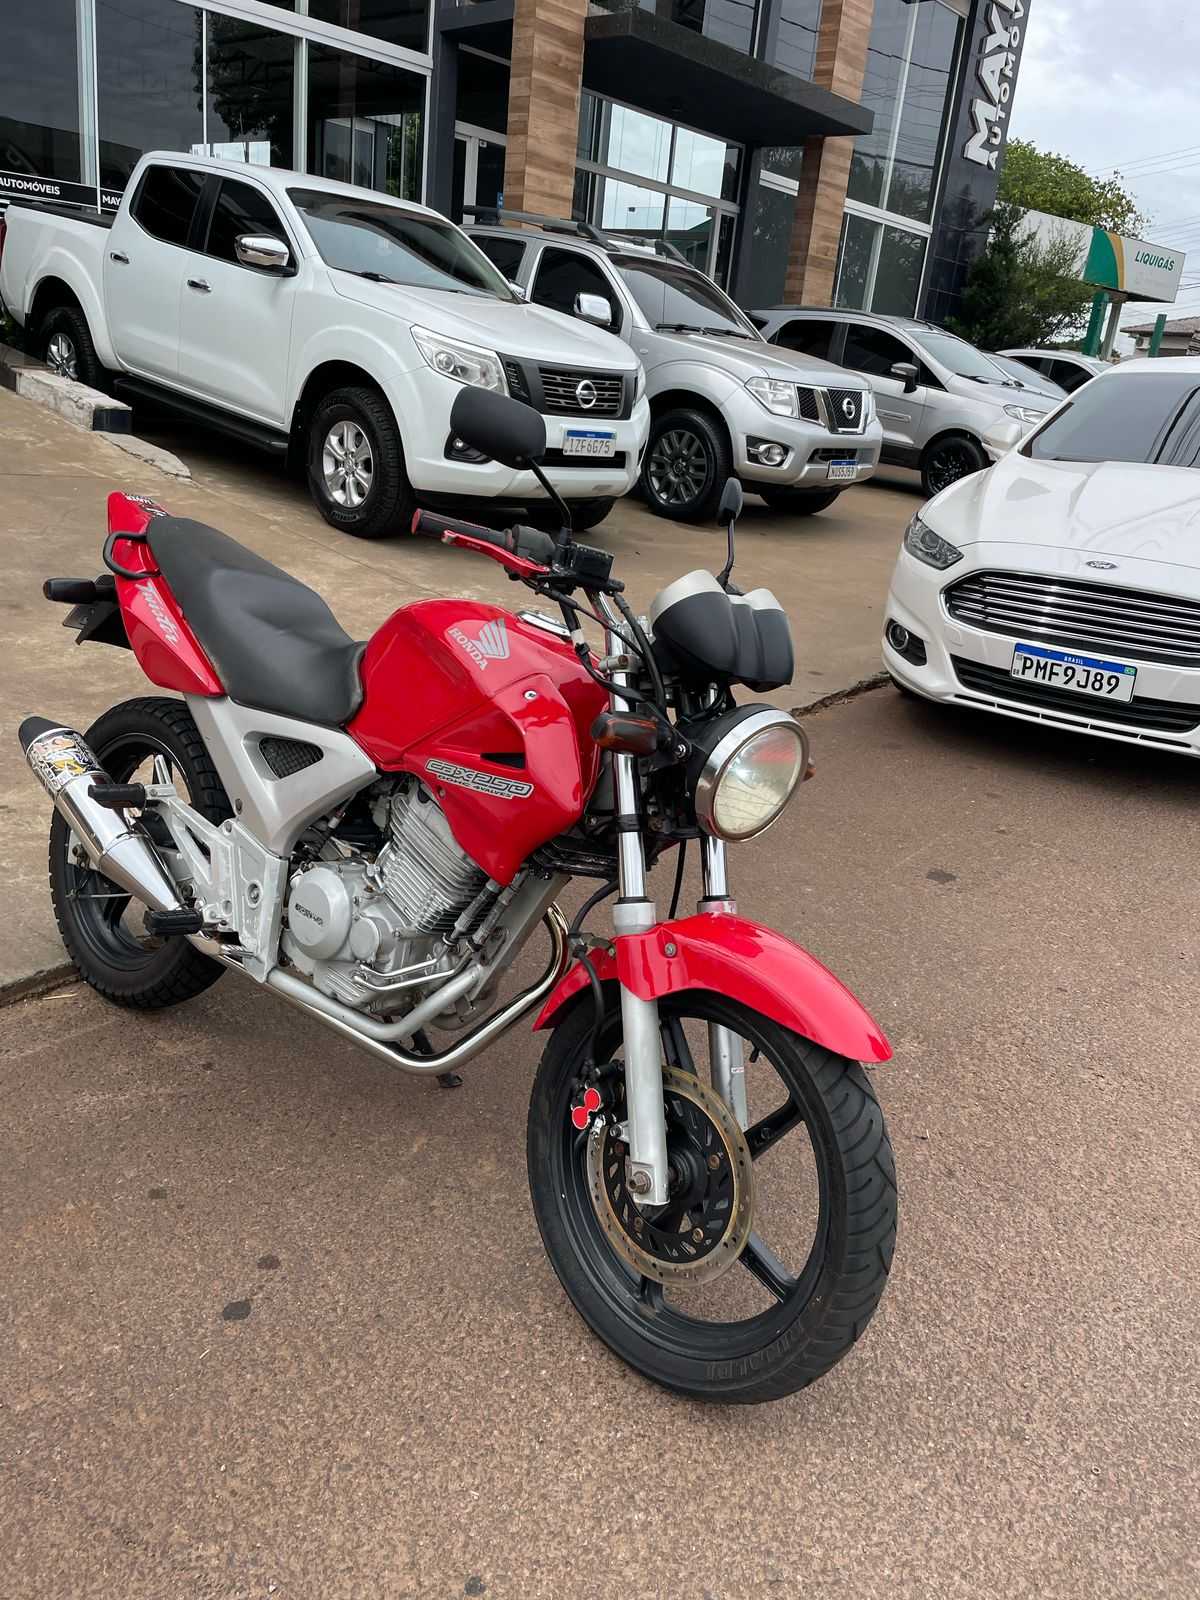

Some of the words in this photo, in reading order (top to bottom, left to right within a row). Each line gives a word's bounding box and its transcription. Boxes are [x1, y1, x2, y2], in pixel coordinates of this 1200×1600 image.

[0, 177, 61, 195] AUTOMÓVEIS
[1134, 250, 1175, 271] LIQUIGÁS
[447, 627, 488, 671] HONDA
[1063, 655, 1083, 665] BRASIL
[1020, 656, 1120, 694] PMF9J89
[425, 759, 533, 796] CBX250
